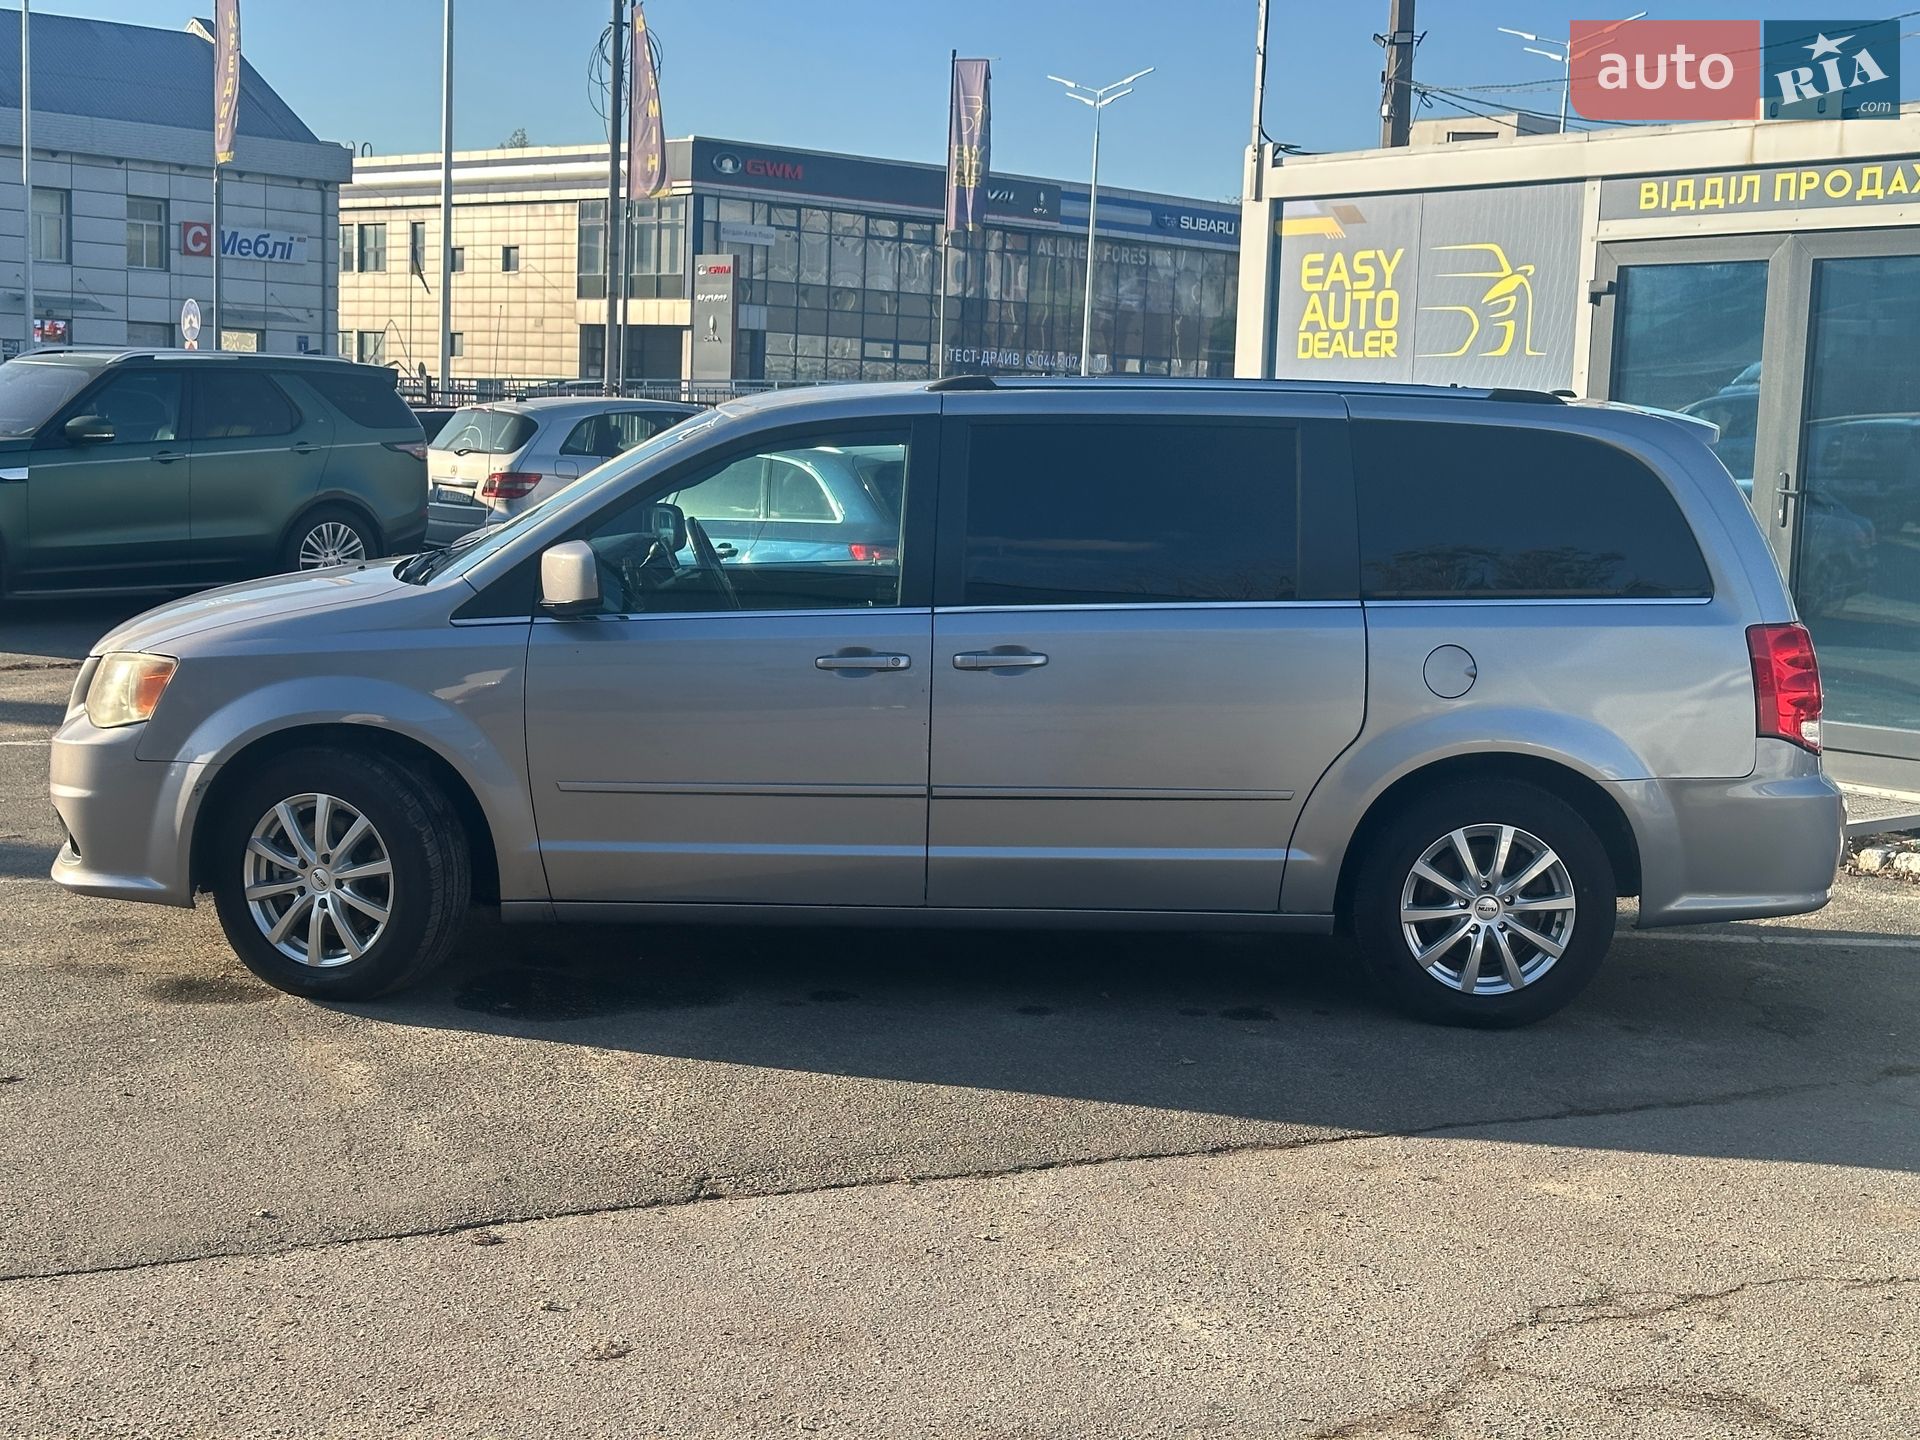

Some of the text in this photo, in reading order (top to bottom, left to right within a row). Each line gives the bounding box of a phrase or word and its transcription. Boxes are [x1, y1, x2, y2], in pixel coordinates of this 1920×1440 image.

[218, 10, 236, 140] КРЕДИТ
[746, 160, 804, 180] GWM
[1639, 174, 1761, 211] ВІДДІЛ
[186, 225, 295, 260] С Меблі
[1180, 215, 1235, 235] SUBARU
[708, 265, 731, 275] GWM
[1301, 248, 1405, 292] EASY
[1299, 289, 1400, 331] AUTO
[1297, 330, 1397, 359] DEALER
